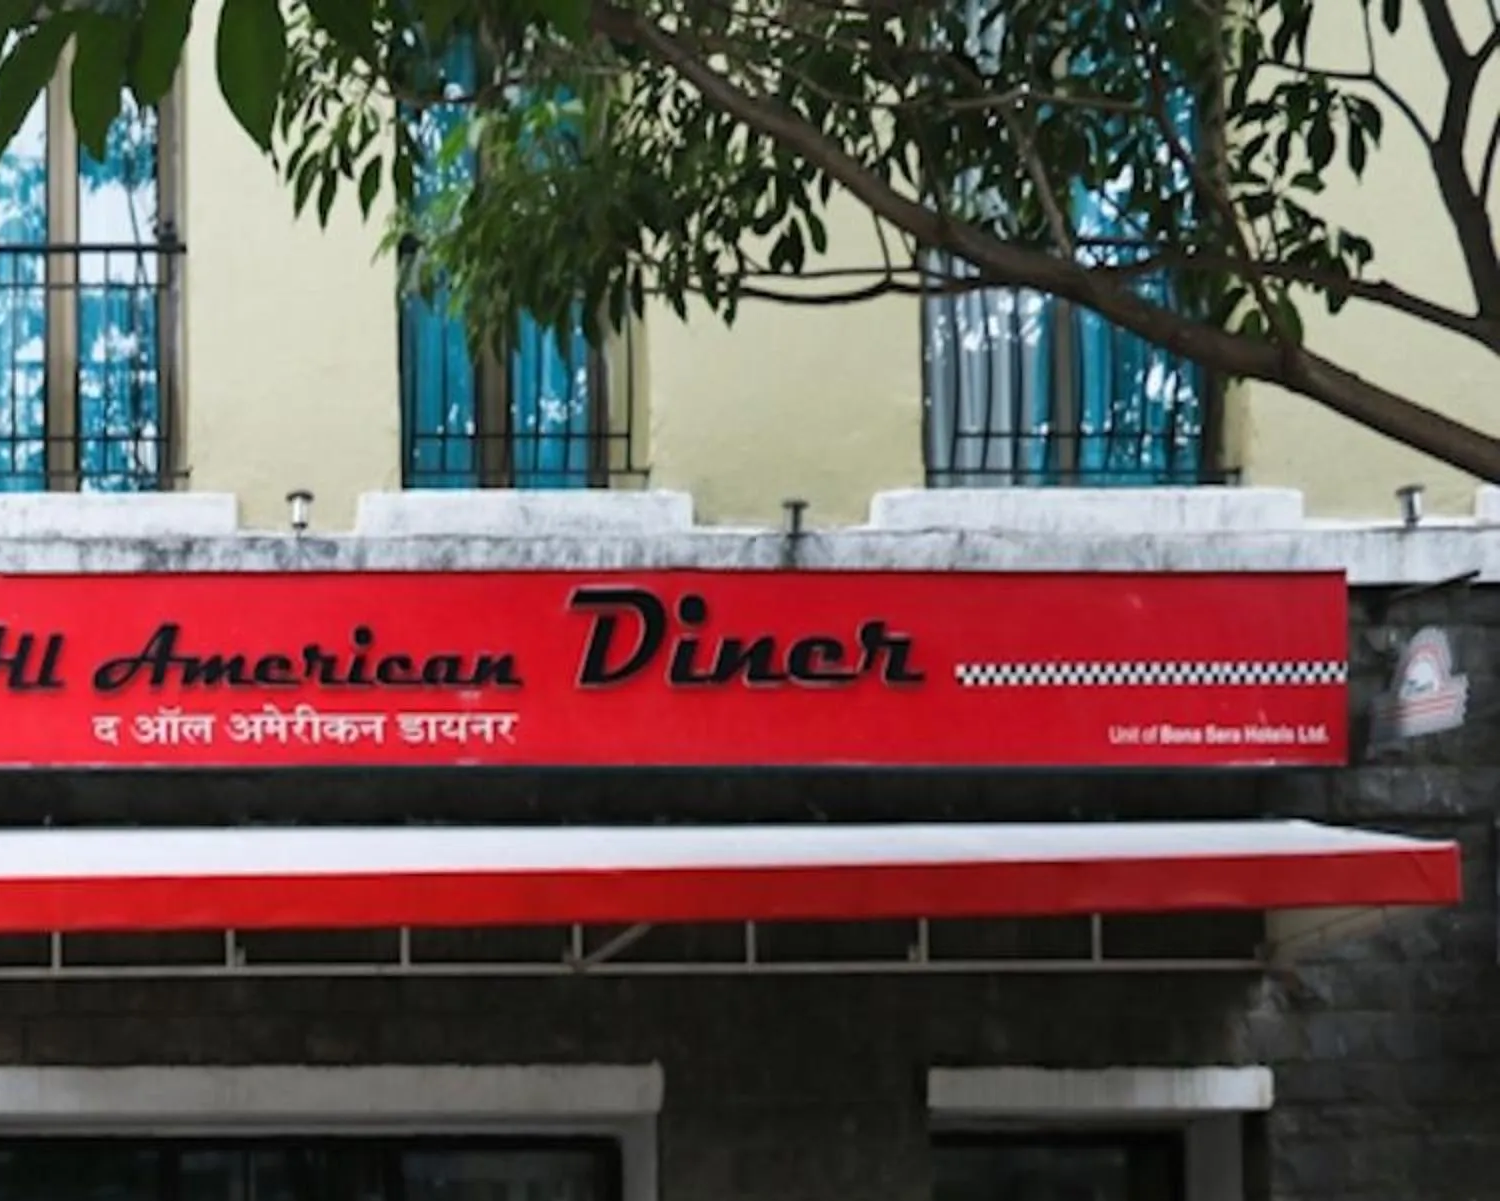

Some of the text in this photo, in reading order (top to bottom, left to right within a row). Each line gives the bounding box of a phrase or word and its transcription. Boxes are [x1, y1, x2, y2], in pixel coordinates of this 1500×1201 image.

[92, 623, 524, 694] American
[568, 589, 924, 689] Diner
[93, 703, 519, 745] द ऑल अमेरीकन डायनर
[1108, 726, 1140, 744] Unit
[1142, 727, 1158, 744] of
